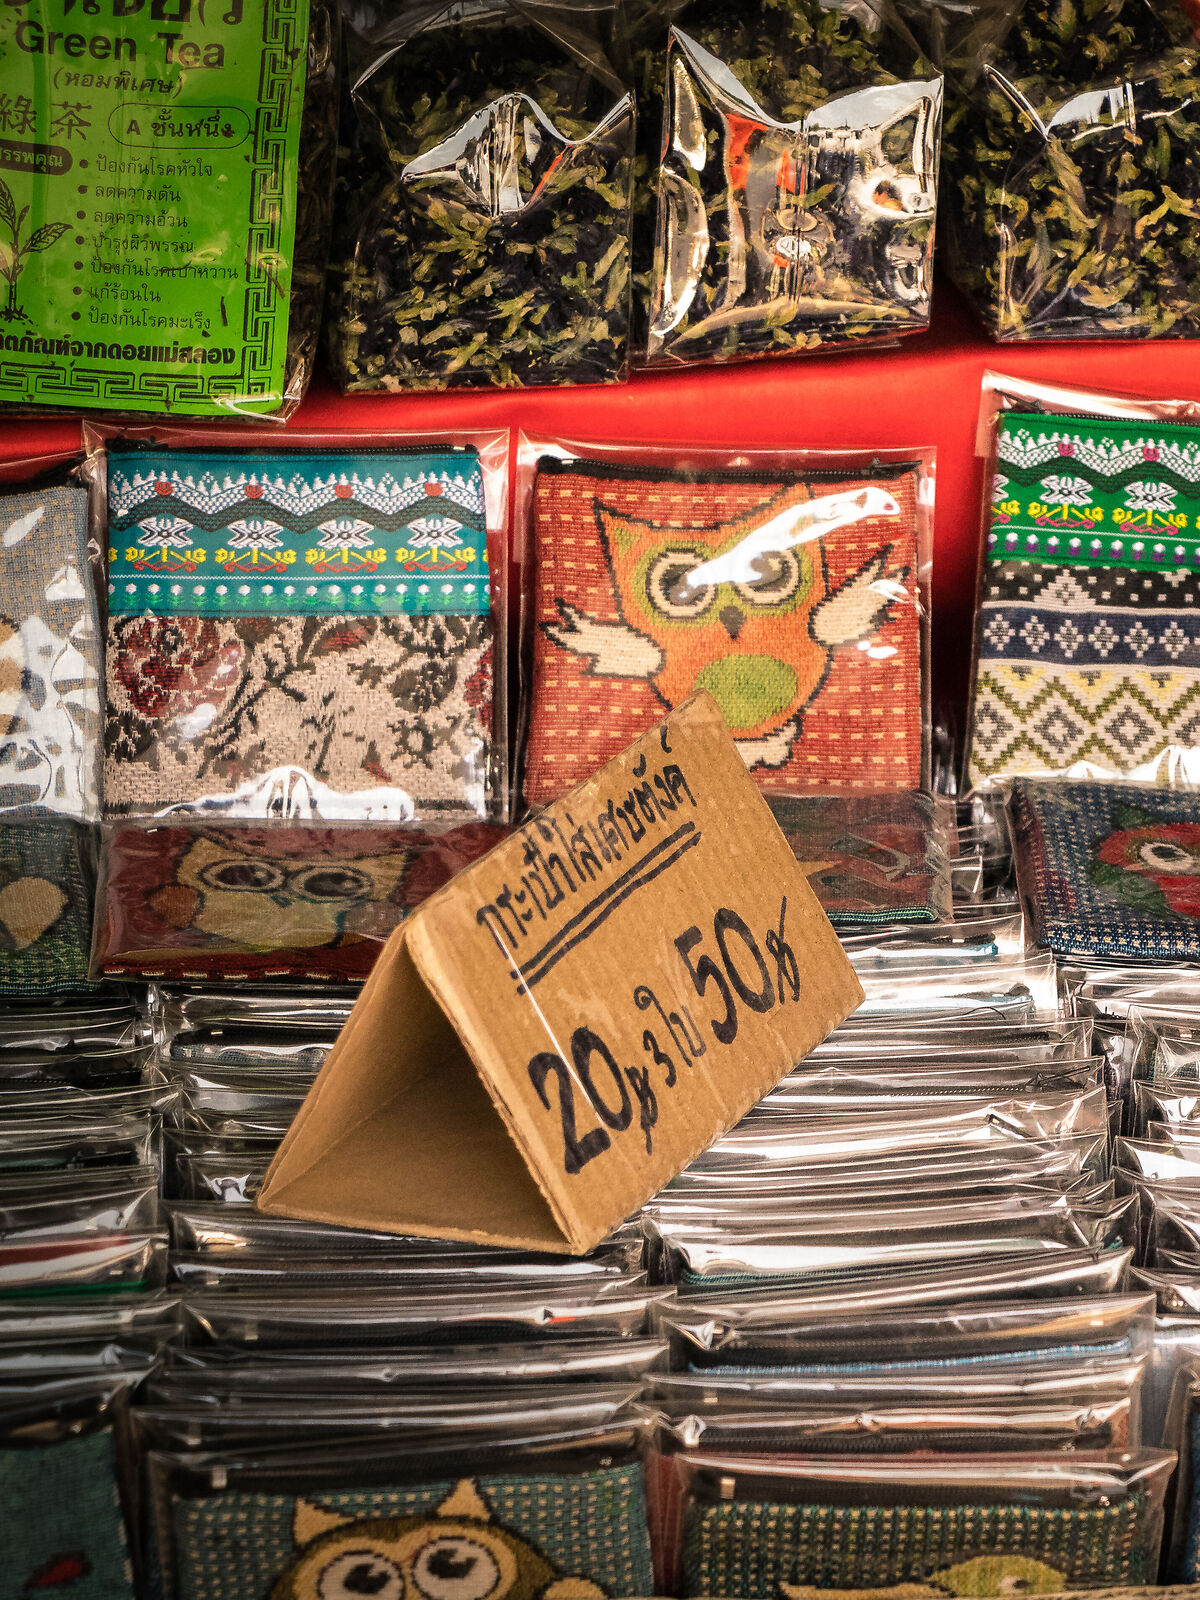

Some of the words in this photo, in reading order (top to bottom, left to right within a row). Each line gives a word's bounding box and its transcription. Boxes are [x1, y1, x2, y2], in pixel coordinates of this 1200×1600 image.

[15, 19, 137, 62] Green
[156, 31, 225, 67] Tea
[125, 118, 141, 136] A
[0, 149, 63, 173] รรพคุณ
[96, 153, 213, 177] ป้องกันโรคหัวใจ
[95, 184, 182, 202] ลดความดัน
